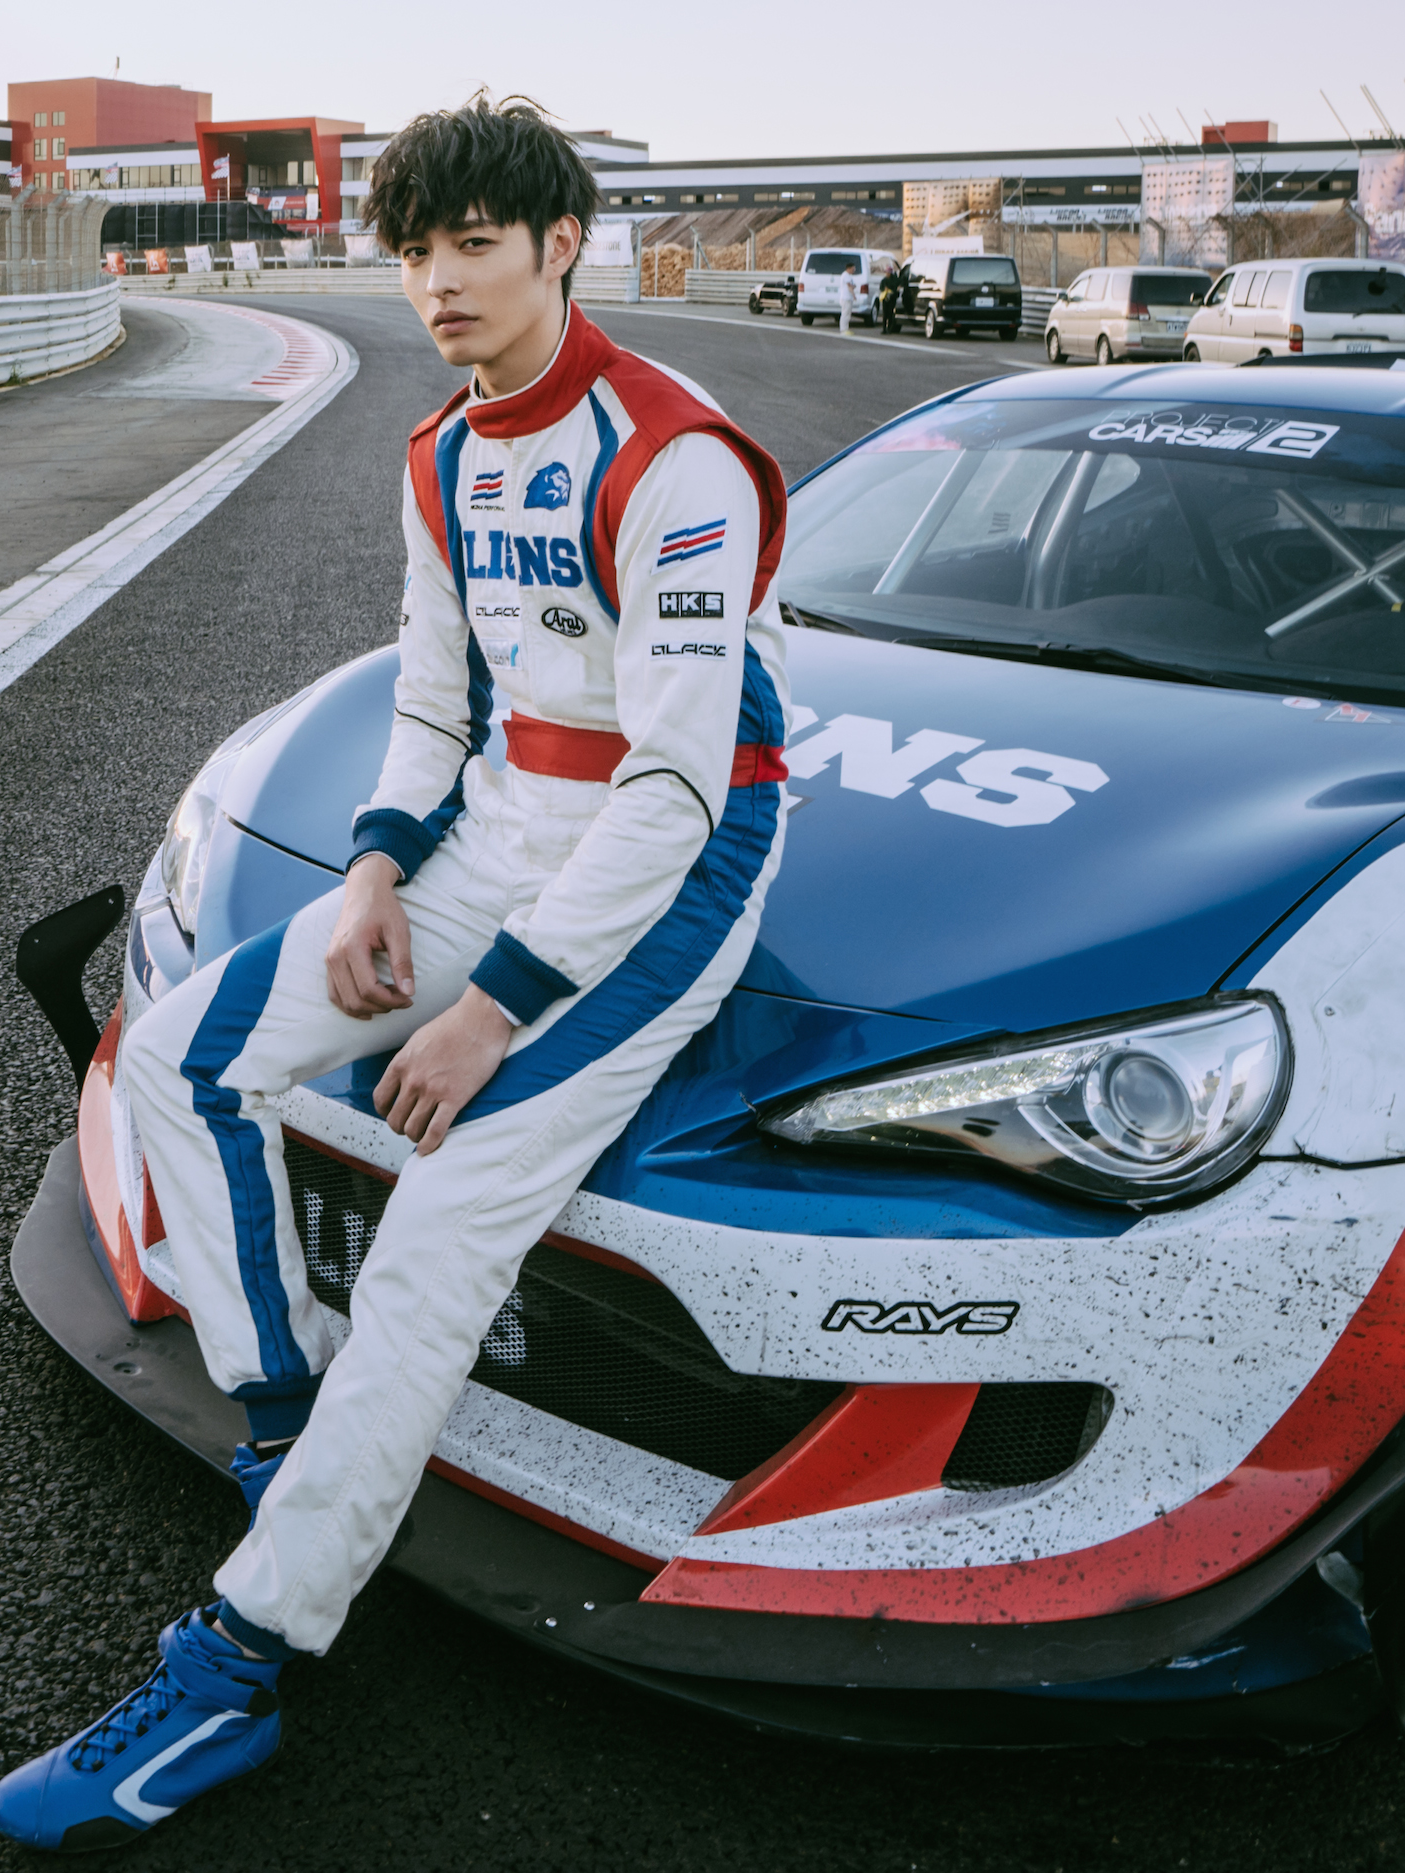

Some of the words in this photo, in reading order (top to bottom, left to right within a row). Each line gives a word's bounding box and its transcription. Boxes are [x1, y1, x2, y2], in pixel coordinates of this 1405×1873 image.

[1101, 410, 1280, 434] PROJECT
[1089, 423, 1213, 446] CARS
[661, 593, 723, 612] HKS
[821, 1300, 1020, 1334] RAYS
